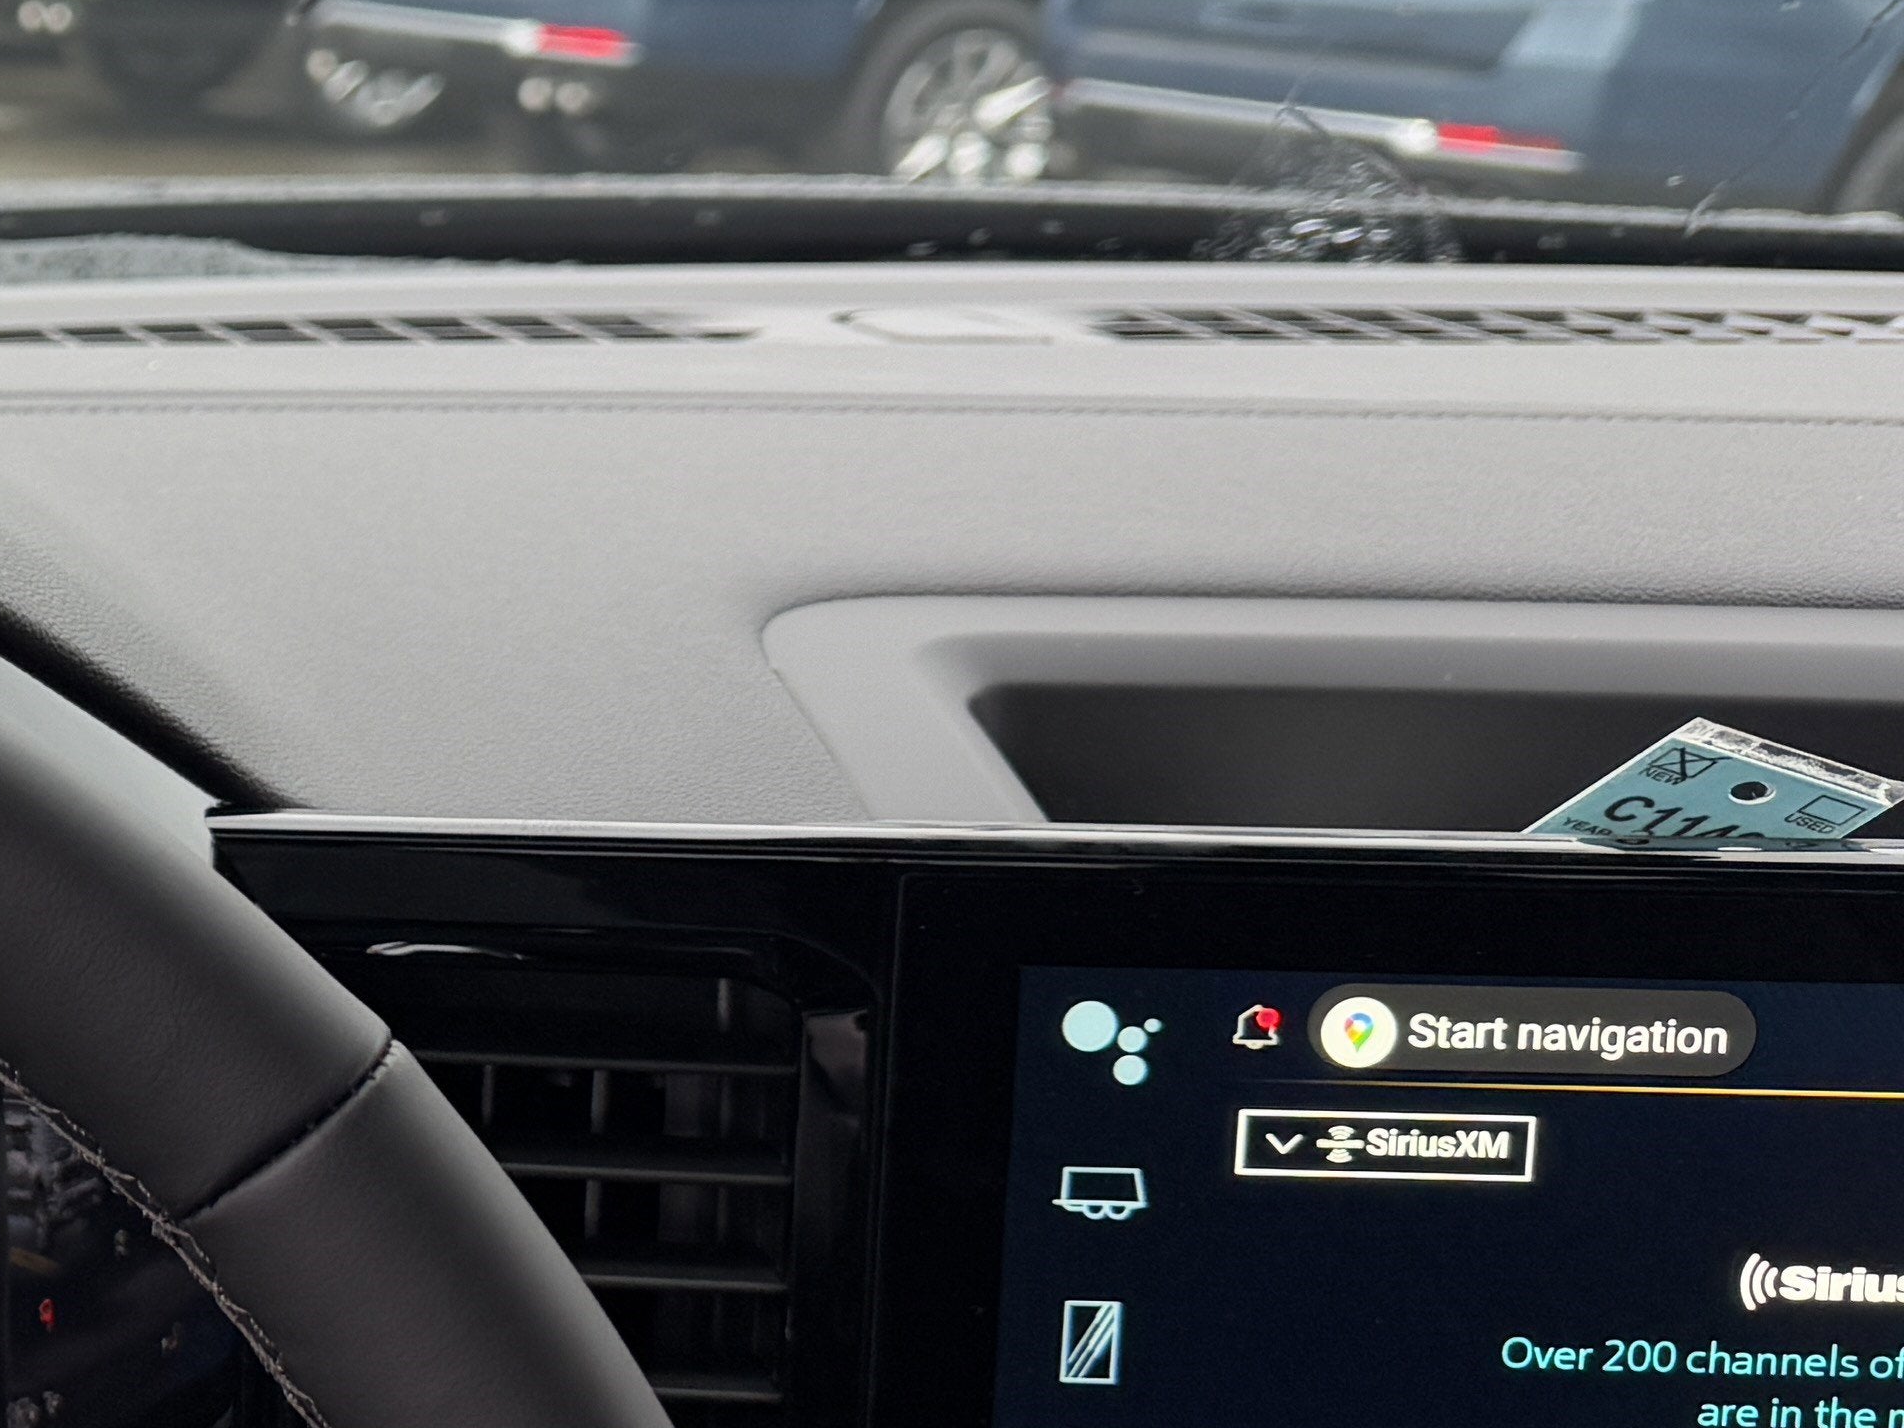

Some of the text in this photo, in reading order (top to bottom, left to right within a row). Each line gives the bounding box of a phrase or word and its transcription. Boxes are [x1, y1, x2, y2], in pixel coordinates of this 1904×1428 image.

[1783, 812, 1835, 835] USED
[1406, 1012, 1729, 1060] Start navigation
[1365, 1127, 1510, 1161] SiriusXM
[1778, 1264, 1904, 1303] Siriu
[1500, 1336, 1904, 1379] Over 200 channels of
[1696, 1402, 1759, 1428] are
